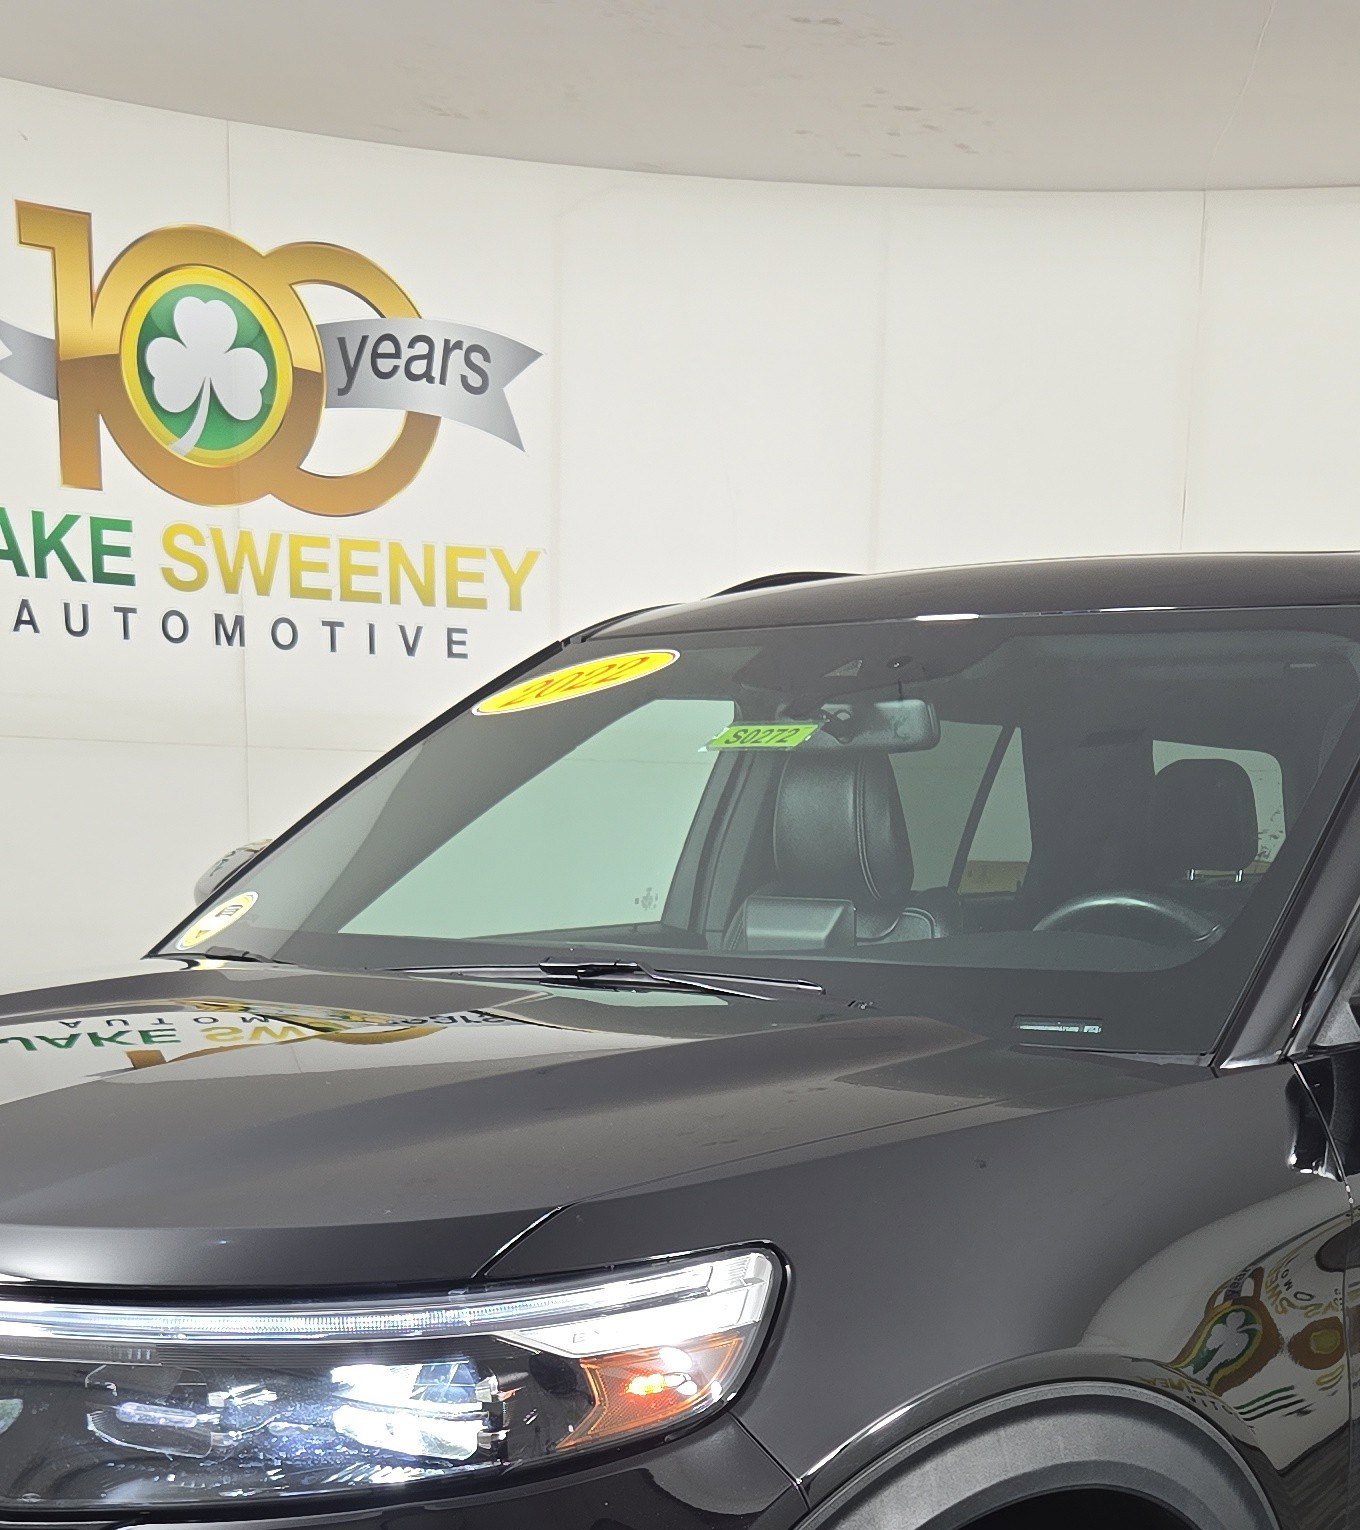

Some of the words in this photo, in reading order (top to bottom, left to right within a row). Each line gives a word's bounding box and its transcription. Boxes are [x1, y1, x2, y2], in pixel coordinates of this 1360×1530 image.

[14, 199, 441, 518] 100
[336, 332, 493, 396] years
[160, 523, 541, 612] SWEENEY
[12, 598, 469, 660] AUTOMOTIVE
[498, 656, 650, 708] 2022
[724, 728, 801, 745] S0272
